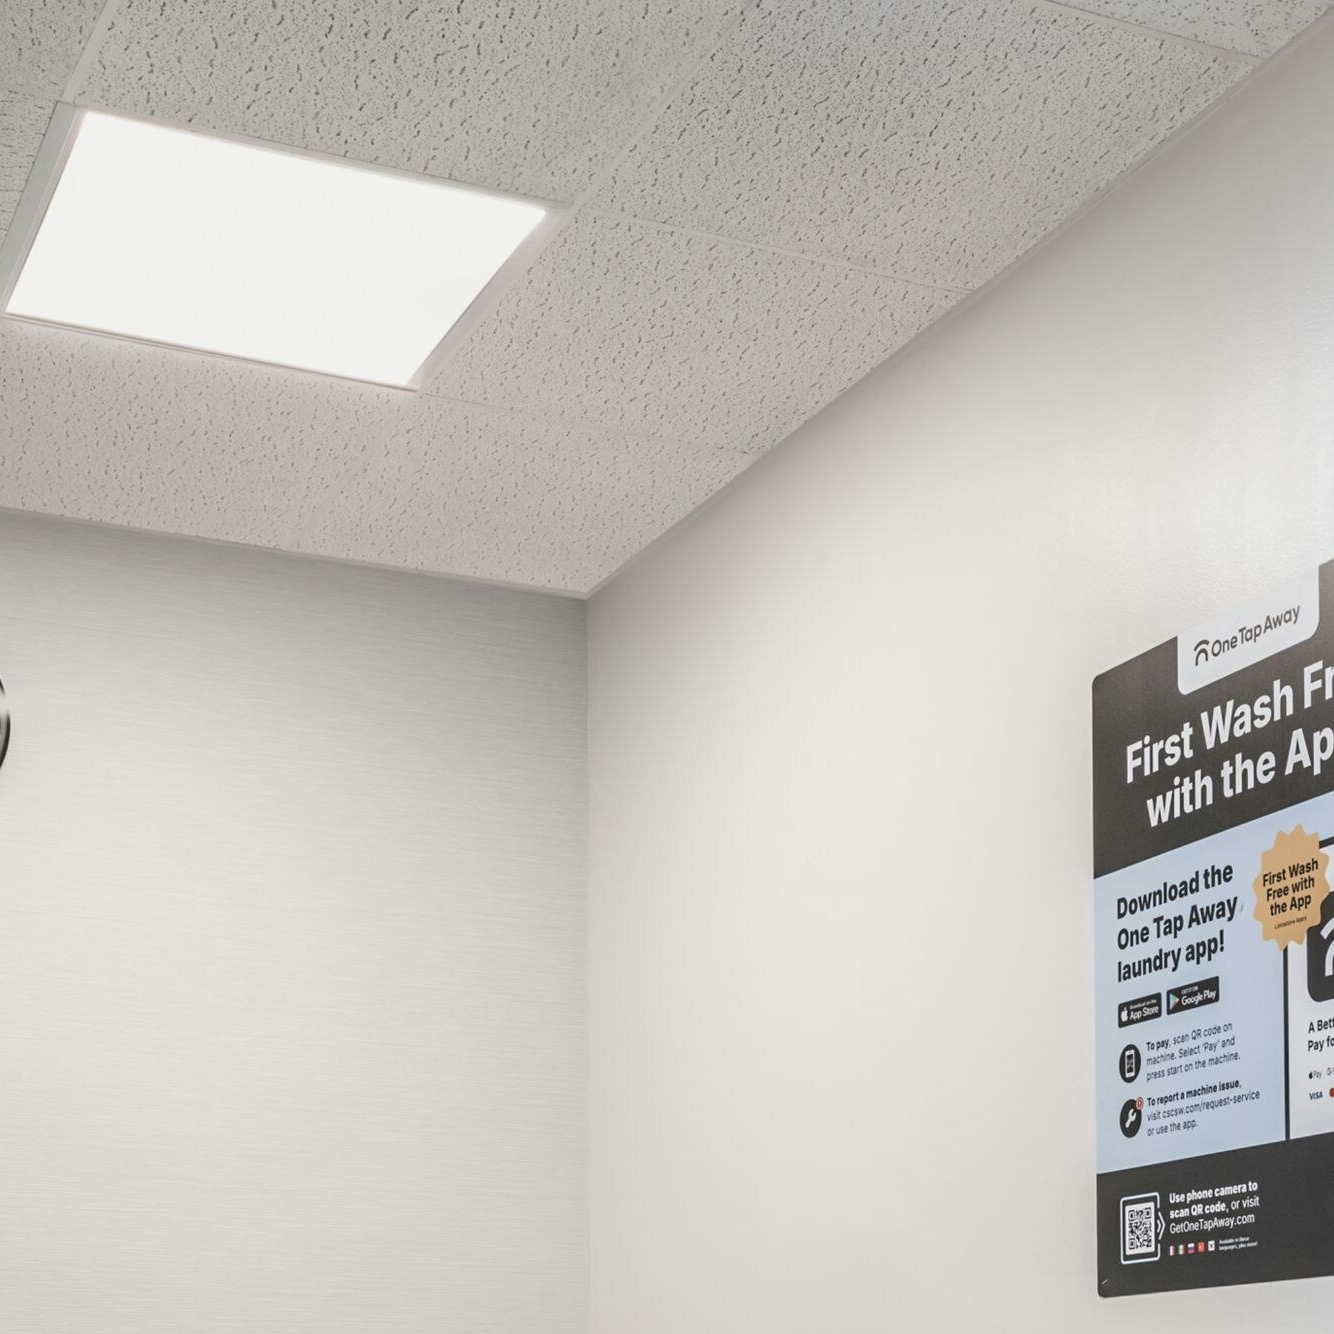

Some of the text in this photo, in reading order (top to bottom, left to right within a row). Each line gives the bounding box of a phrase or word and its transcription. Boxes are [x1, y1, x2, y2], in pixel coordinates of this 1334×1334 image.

[1211, 605, 1300, 658] One Tap Away
[1126, 721, 1194, 784] First
[1201, 679, 1293, 750] Wash
[1146, 769, 1213, 828] with
[1221, 751, 1275, 798] the
[1263, 858, 1318, 887] First Wash
[1117, 865, 1233, 919] Download the
[1267, 876, 1315, 902] Free with
[1270, 895, 1311, 916] the App
[1118, 897, 1237, 950] One Tap Away
[1118, 930, 1224, 982] laundry app!
[1182, 992, 1203, 1006] Google
[1204, 989, 1217, 1000] Play
[1130, 1006, 1158, 1021] App Store
[1146, 1023, 1232, 1053] To pay, scan QR code on
[1308, 1022, 1315, 1034] A
[1146, 1052, 1176, 1066] machine.
[1179, 1045, 1200, 1058] Select
[1222, 1036, 1235, 1048] and
[1308, 1040, 1324, 1052] Pay
[1147, 1052, 1240, 1082] press start on the machine.
[1147, 1079, 1241, 1106] To report a machine issue,
[1309, 1091, 1323, 1100] VISA
[1147, 1110, 1161, 1122] visit
[1147, 1118, 1197, 1136] or use the app.
[1169, 1181, 1258, 1204] Use phone camera to
[1170, 1196, 1259, 1219] scan QR code, or visit
[1169, 1213, 1255, 1234] GetOneTapAway.com
